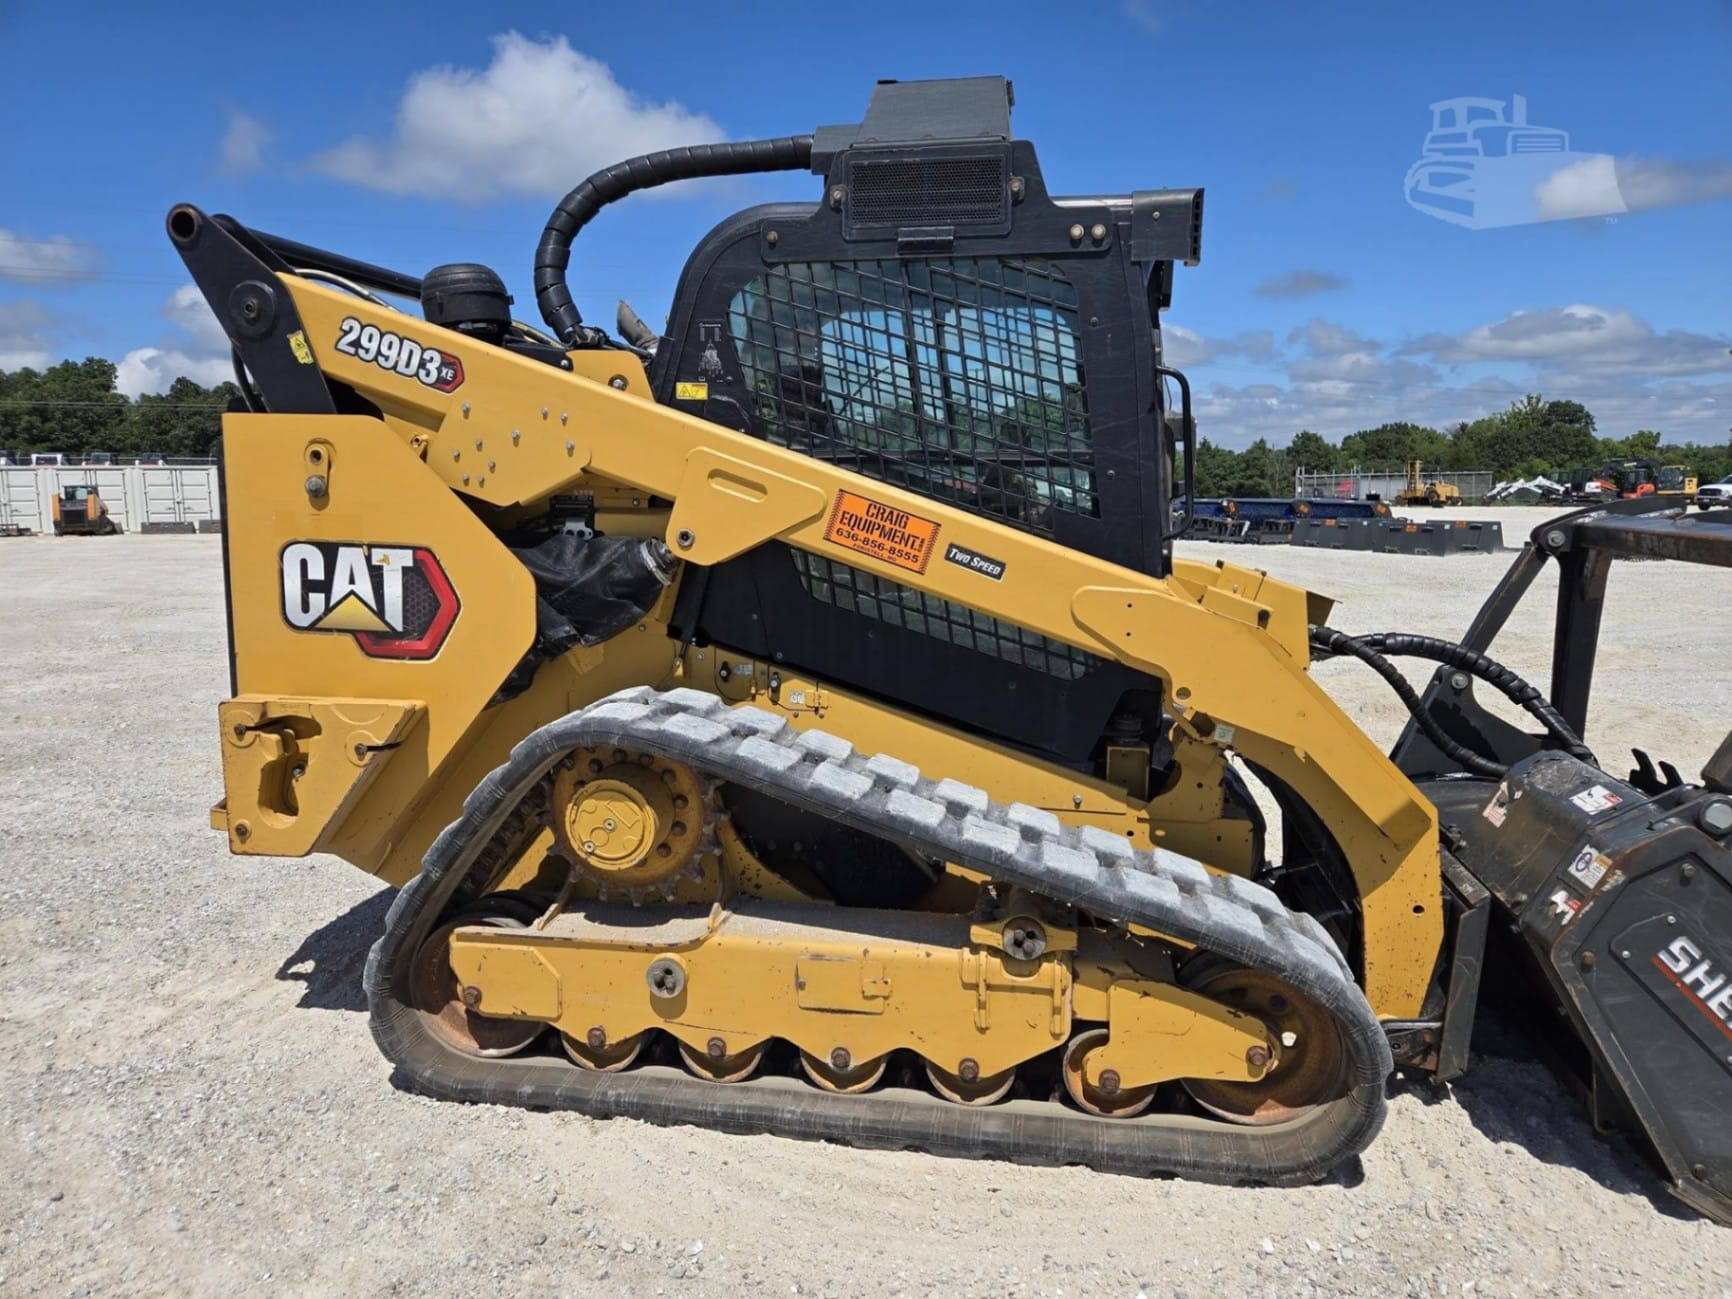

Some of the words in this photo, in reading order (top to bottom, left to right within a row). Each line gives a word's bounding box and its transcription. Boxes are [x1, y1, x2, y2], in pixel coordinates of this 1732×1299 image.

[336, 317, 442, 384] 299D3
[440, 366, 455, 381] XE
[836, 527, 920, 563] 636-856-8555
[865, 502, 909, 530] CRAIG
[283, 543, 413, 632] CAT
[1656, 935, 1732, 1030] SHE
